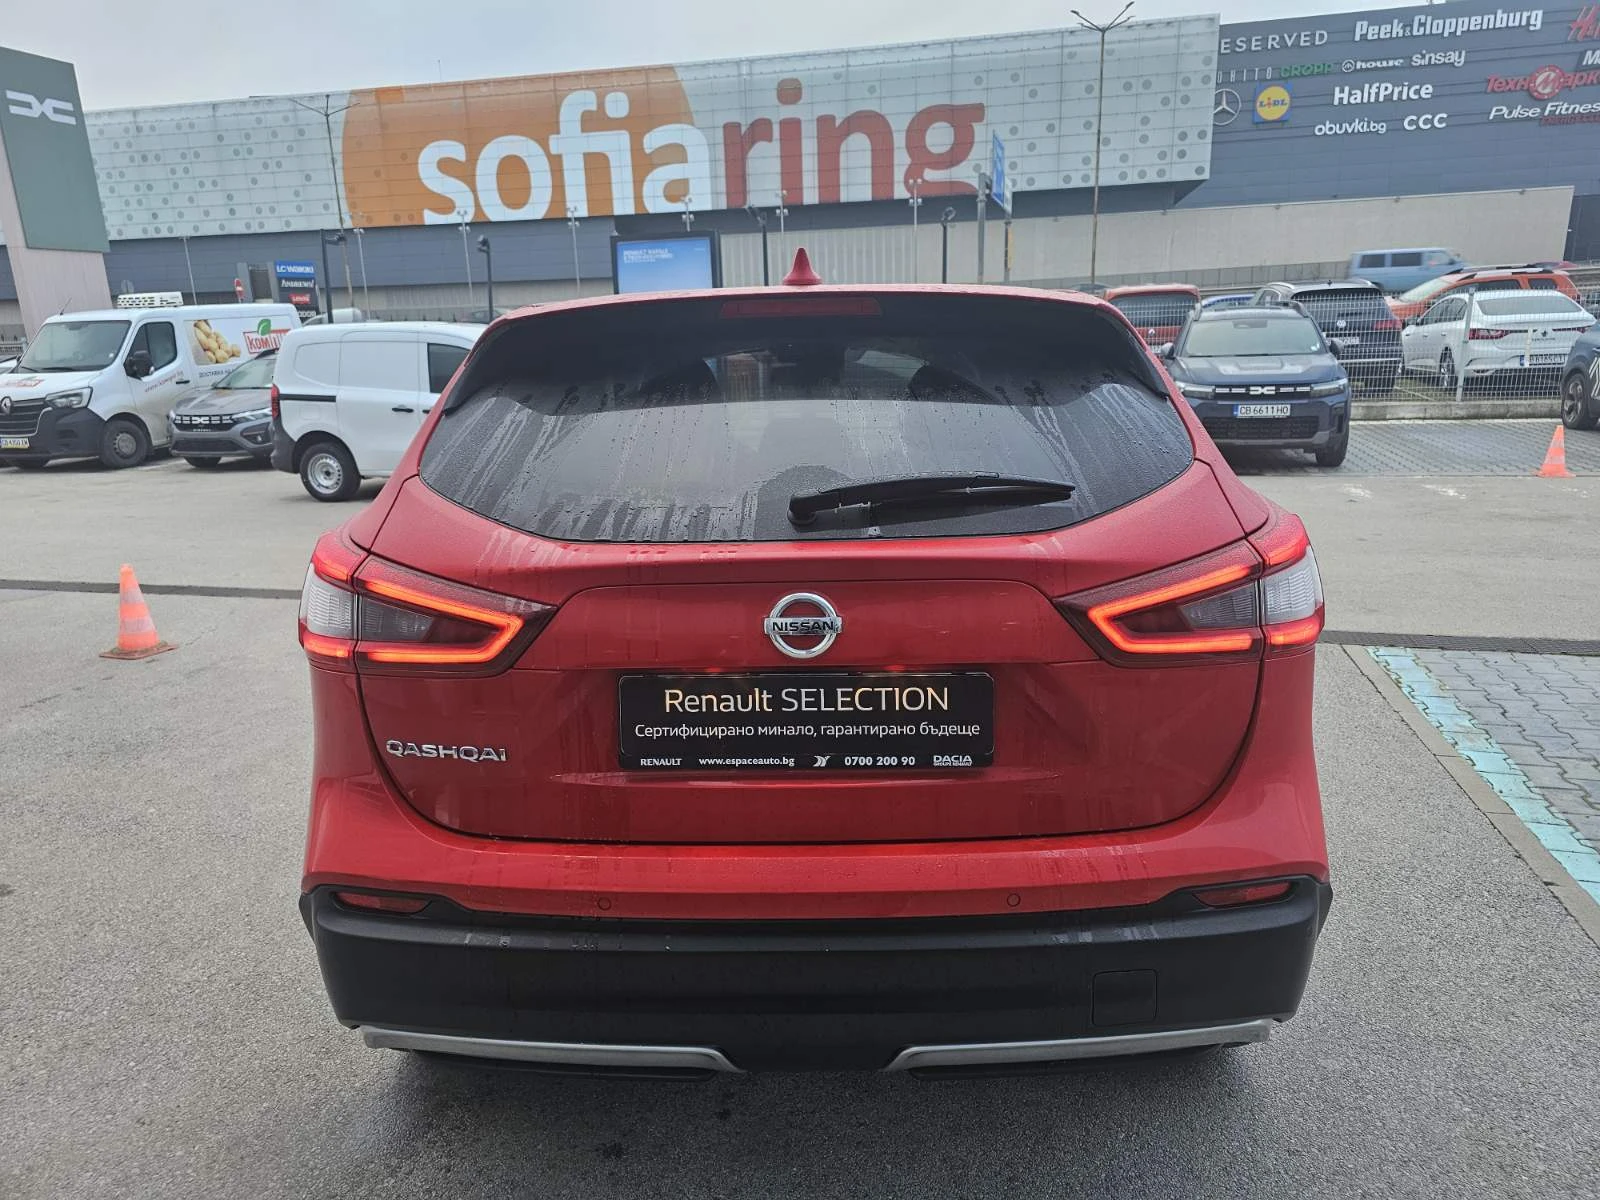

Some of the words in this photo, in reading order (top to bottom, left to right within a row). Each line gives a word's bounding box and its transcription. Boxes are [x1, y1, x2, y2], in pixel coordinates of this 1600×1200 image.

[1220, 30, 1328, 54] ESERVED
[1410, 50, 1466, 67] sinsay
[1216, 66, 1272, 84] OHITO
[1333, 81, 1433, 106] HalfPrice
[1489, 105, 1541, 120] Pulse
[1543, 101, 1600, 116] Fitnes
[1314, 117, 1387, 136] obuvki.bg
[1403, 113, 1448, 131] CCC
[772, 621, 834, 632] NISSAN
[664, 687, 773, 713] Renault
[781, 687, 949, 712] SELECTION
[635, 723, 755, 740] Сертифицирано
[758, 725, 818, 738] минало,
[820, 724, 917, 738] гарантирано
[919, 721, 980, 737] бъдеще
[640, 757, 683, 767] RENAULT
[698, 756, 796, 768] www.espaceauto.bg
[844, 755, 874, 766] 0700
[876, 755, 899, 766] 200
[901, 755, 916, 766] 90
[933, 755, 972, 763] DACIA
